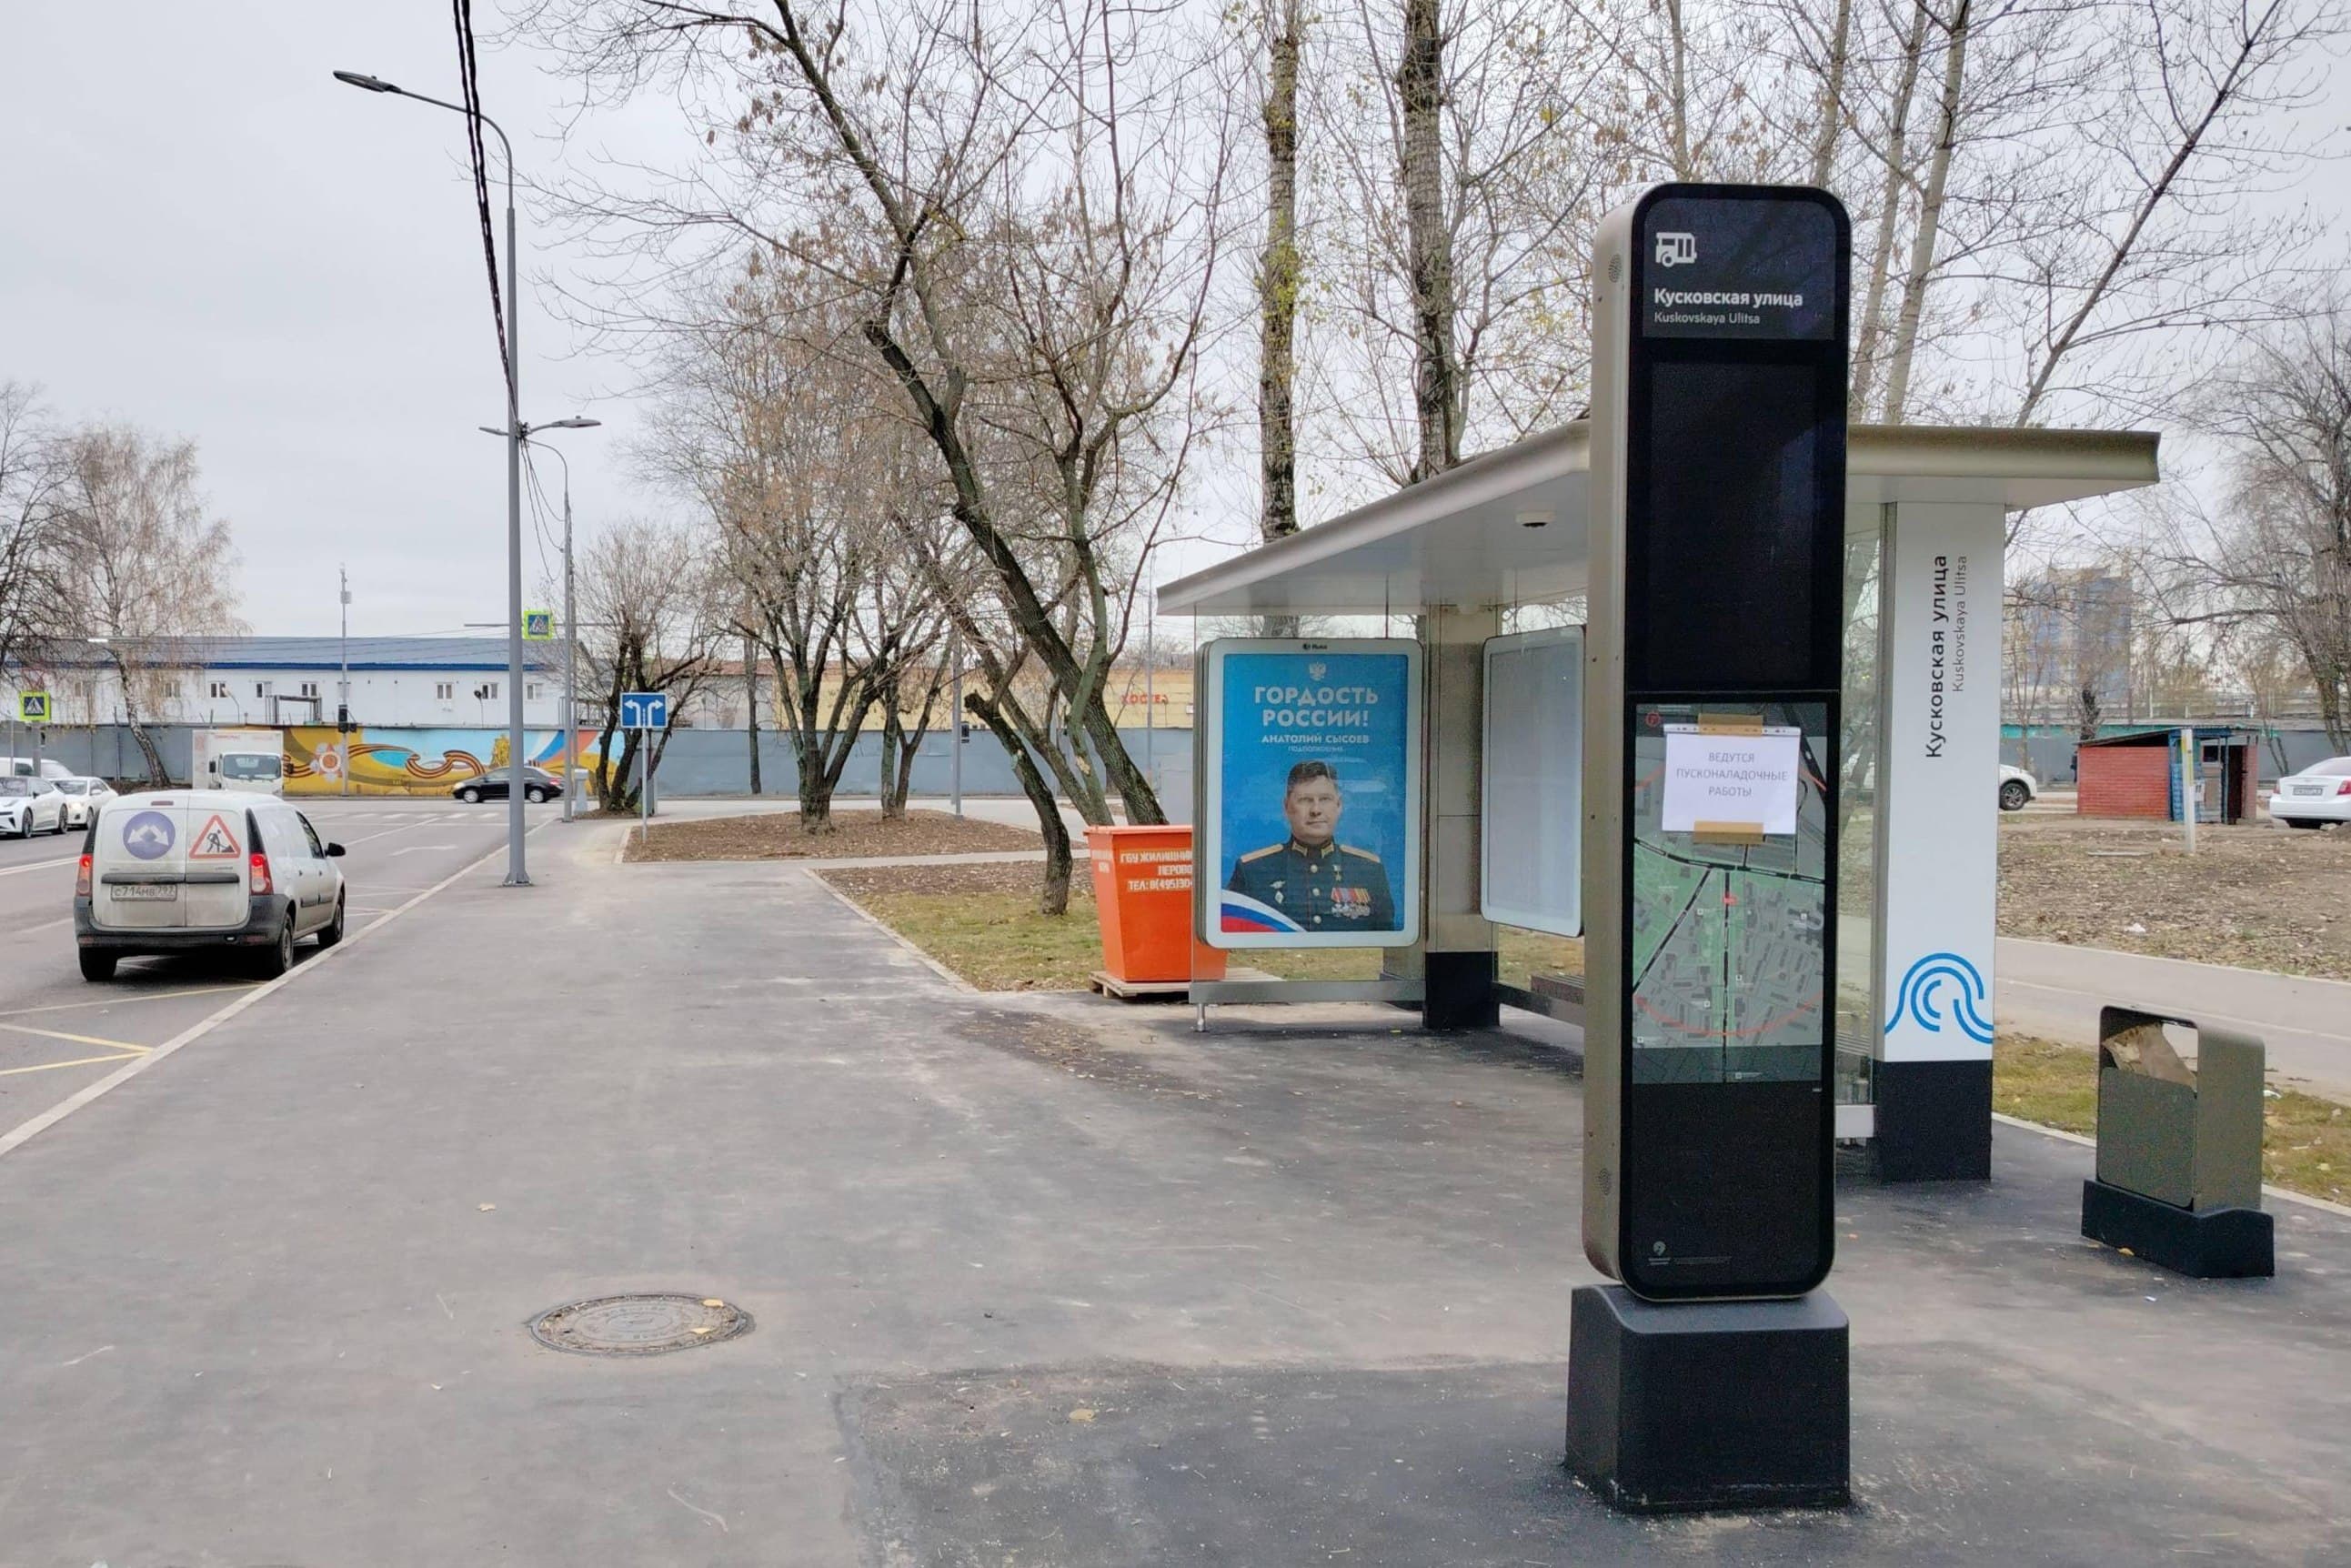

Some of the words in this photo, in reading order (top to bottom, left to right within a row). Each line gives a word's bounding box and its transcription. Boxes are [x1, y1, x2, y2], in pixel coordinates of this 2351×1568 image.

[1654, 288, 1750, 307] Кусковская
[1753, 293, 1803, 308] улица
[1654, 312, 1725, 325] Kuskovskaya
[1729, 313, 1761, 325] Ulitsa
[1954, 556, 1967, 596] Ulitsa
[1933, 556, 1949, 622] улица
[1952, 600, 1969, 692] Kuskovskaya
[1254, 686, 1379, 707] ГОРДОСТЬ
[1925, 630, 1946, 758] Кусковская
[1262, 709, 1369, 727] РОССИИ!
[1261, 732, 1321, 743] АНАТОЛИЙ
[1325, 735, 1370, 743] СЫСОЕВ
[1709, 752, 1754, 763] ВЕДУТСЯ
[1676, 768, 1788, 781] ПУСКОНАЛАДОЧНЫЕ
[1709, 786, 1753, 797] РАБОТЫ
